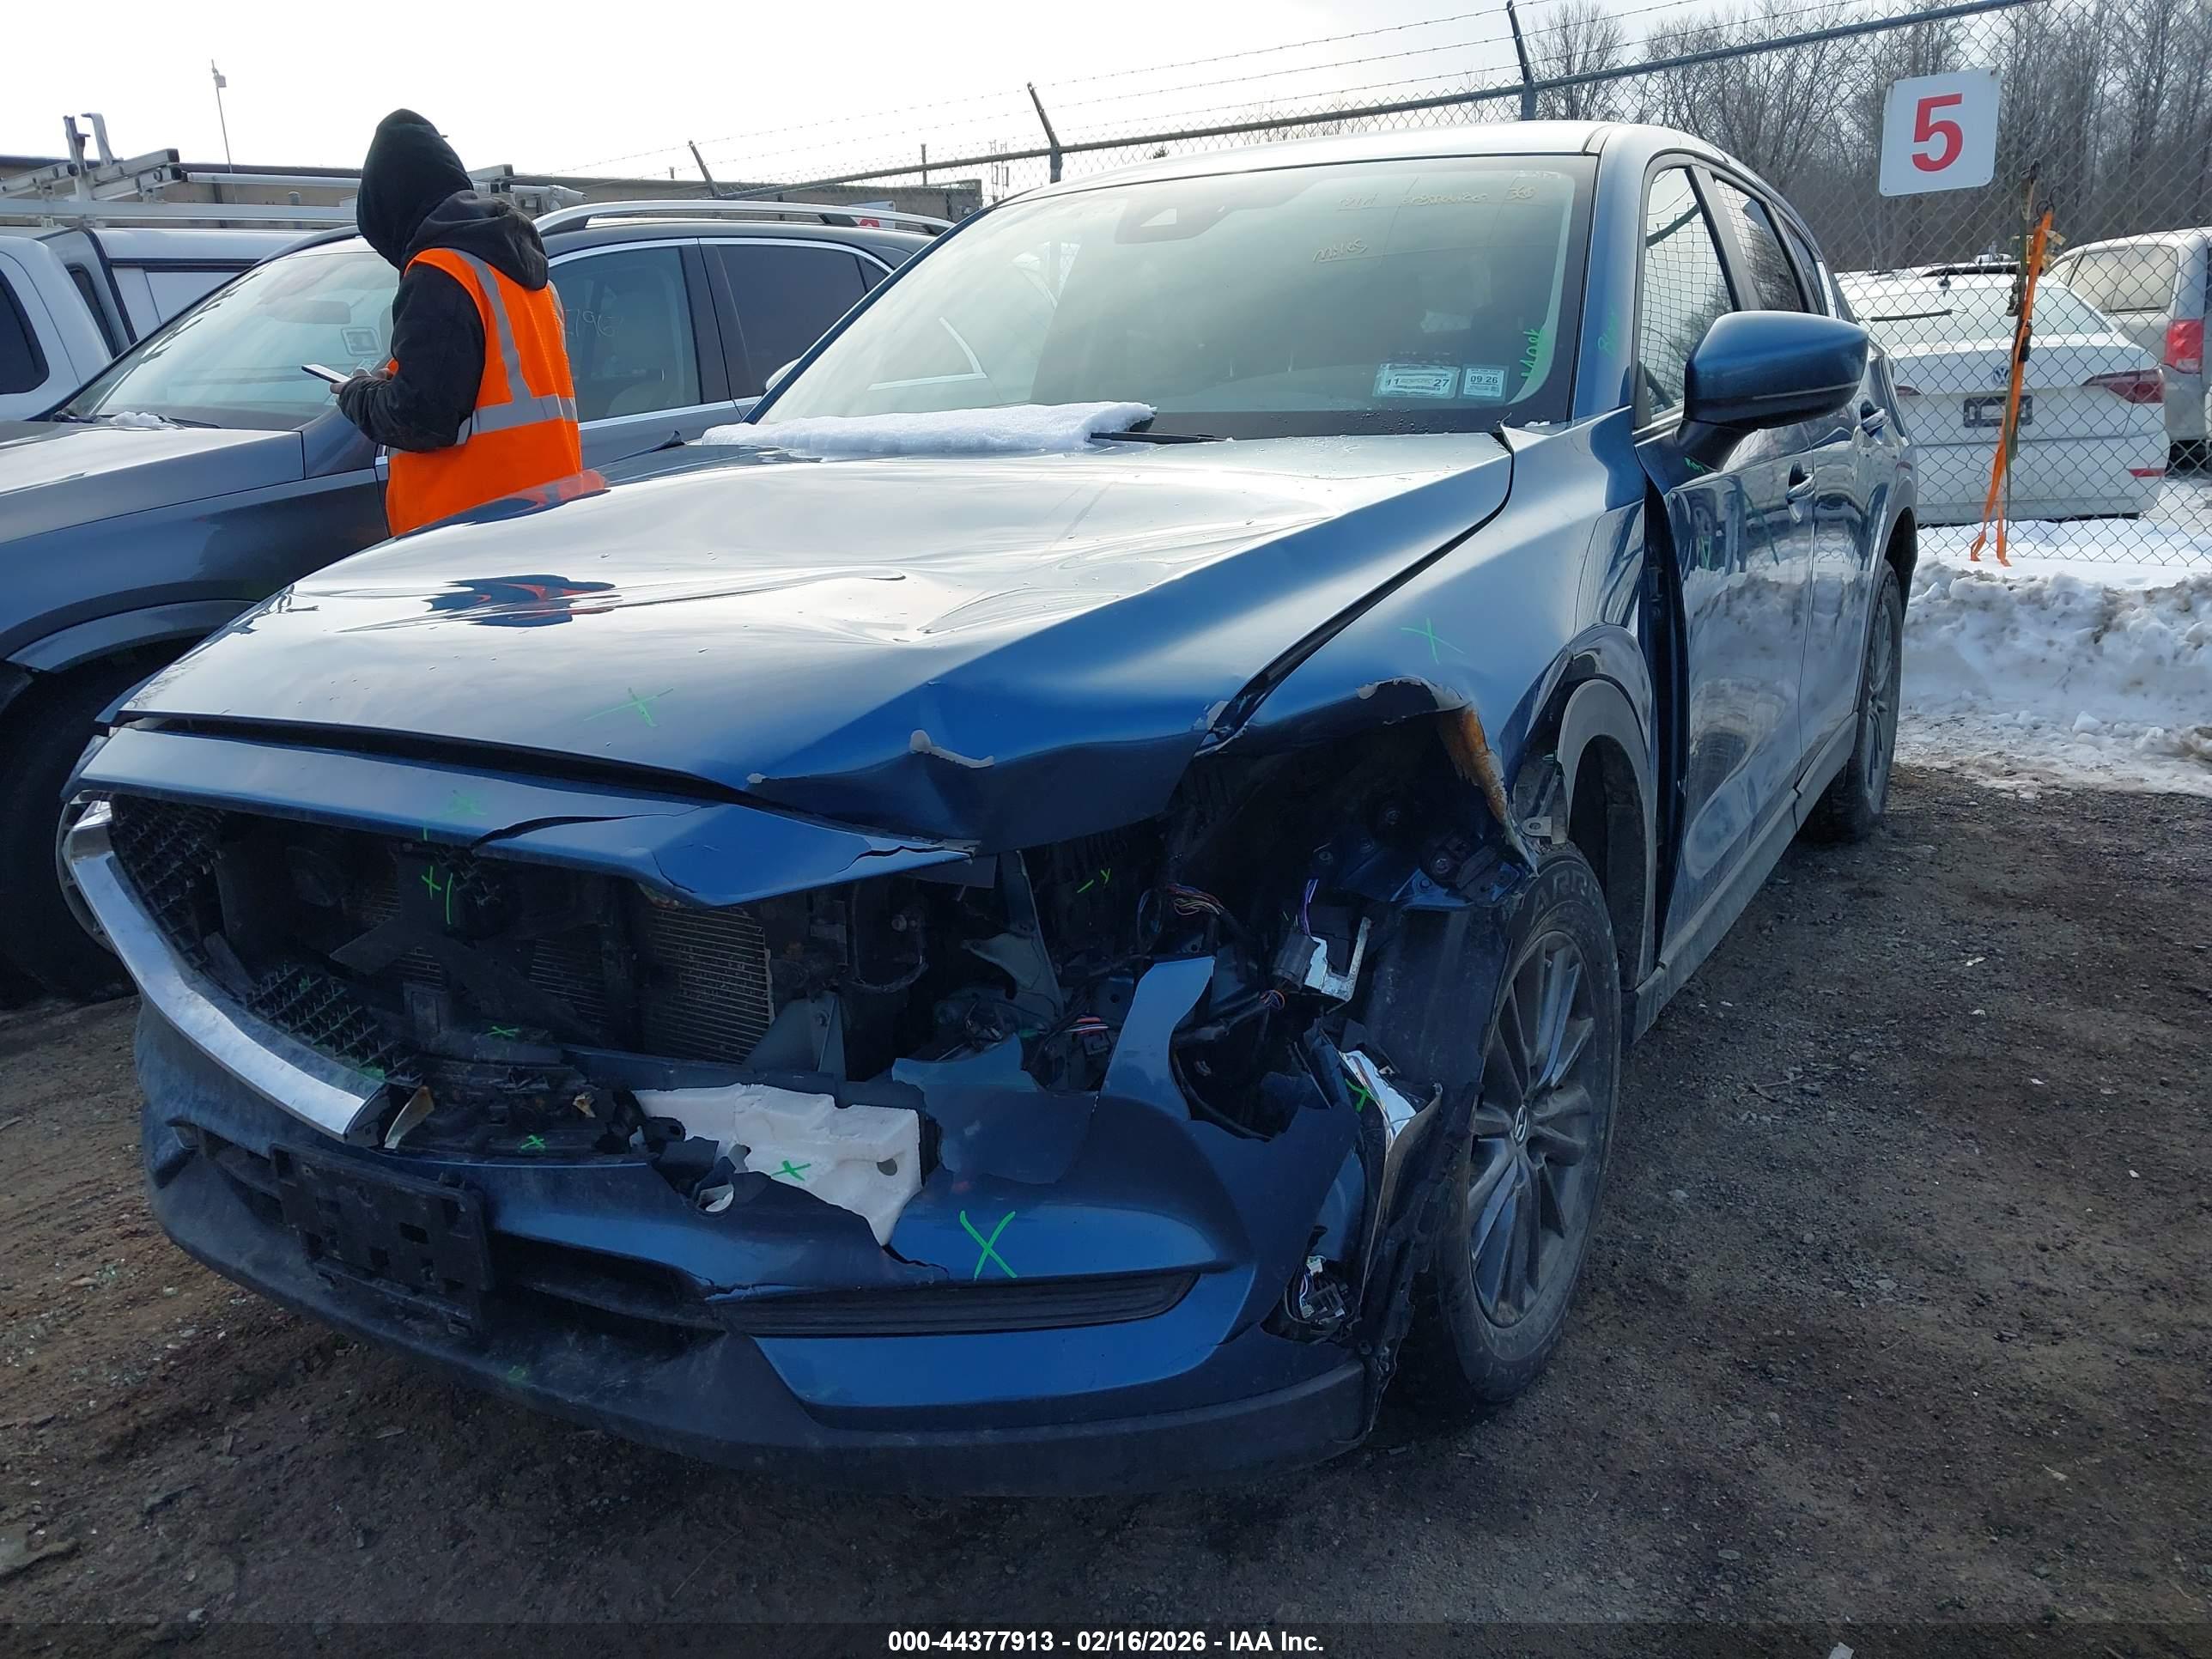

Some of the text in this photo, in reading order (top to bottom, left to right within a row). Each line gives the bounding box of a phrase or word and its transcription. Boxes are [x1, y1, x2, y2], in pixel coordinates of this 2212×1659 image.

[1912, 93, 1963, 172] 5
[1433, 379, 1450, 387] 27
[1485, 375, 1498, 384] 26
